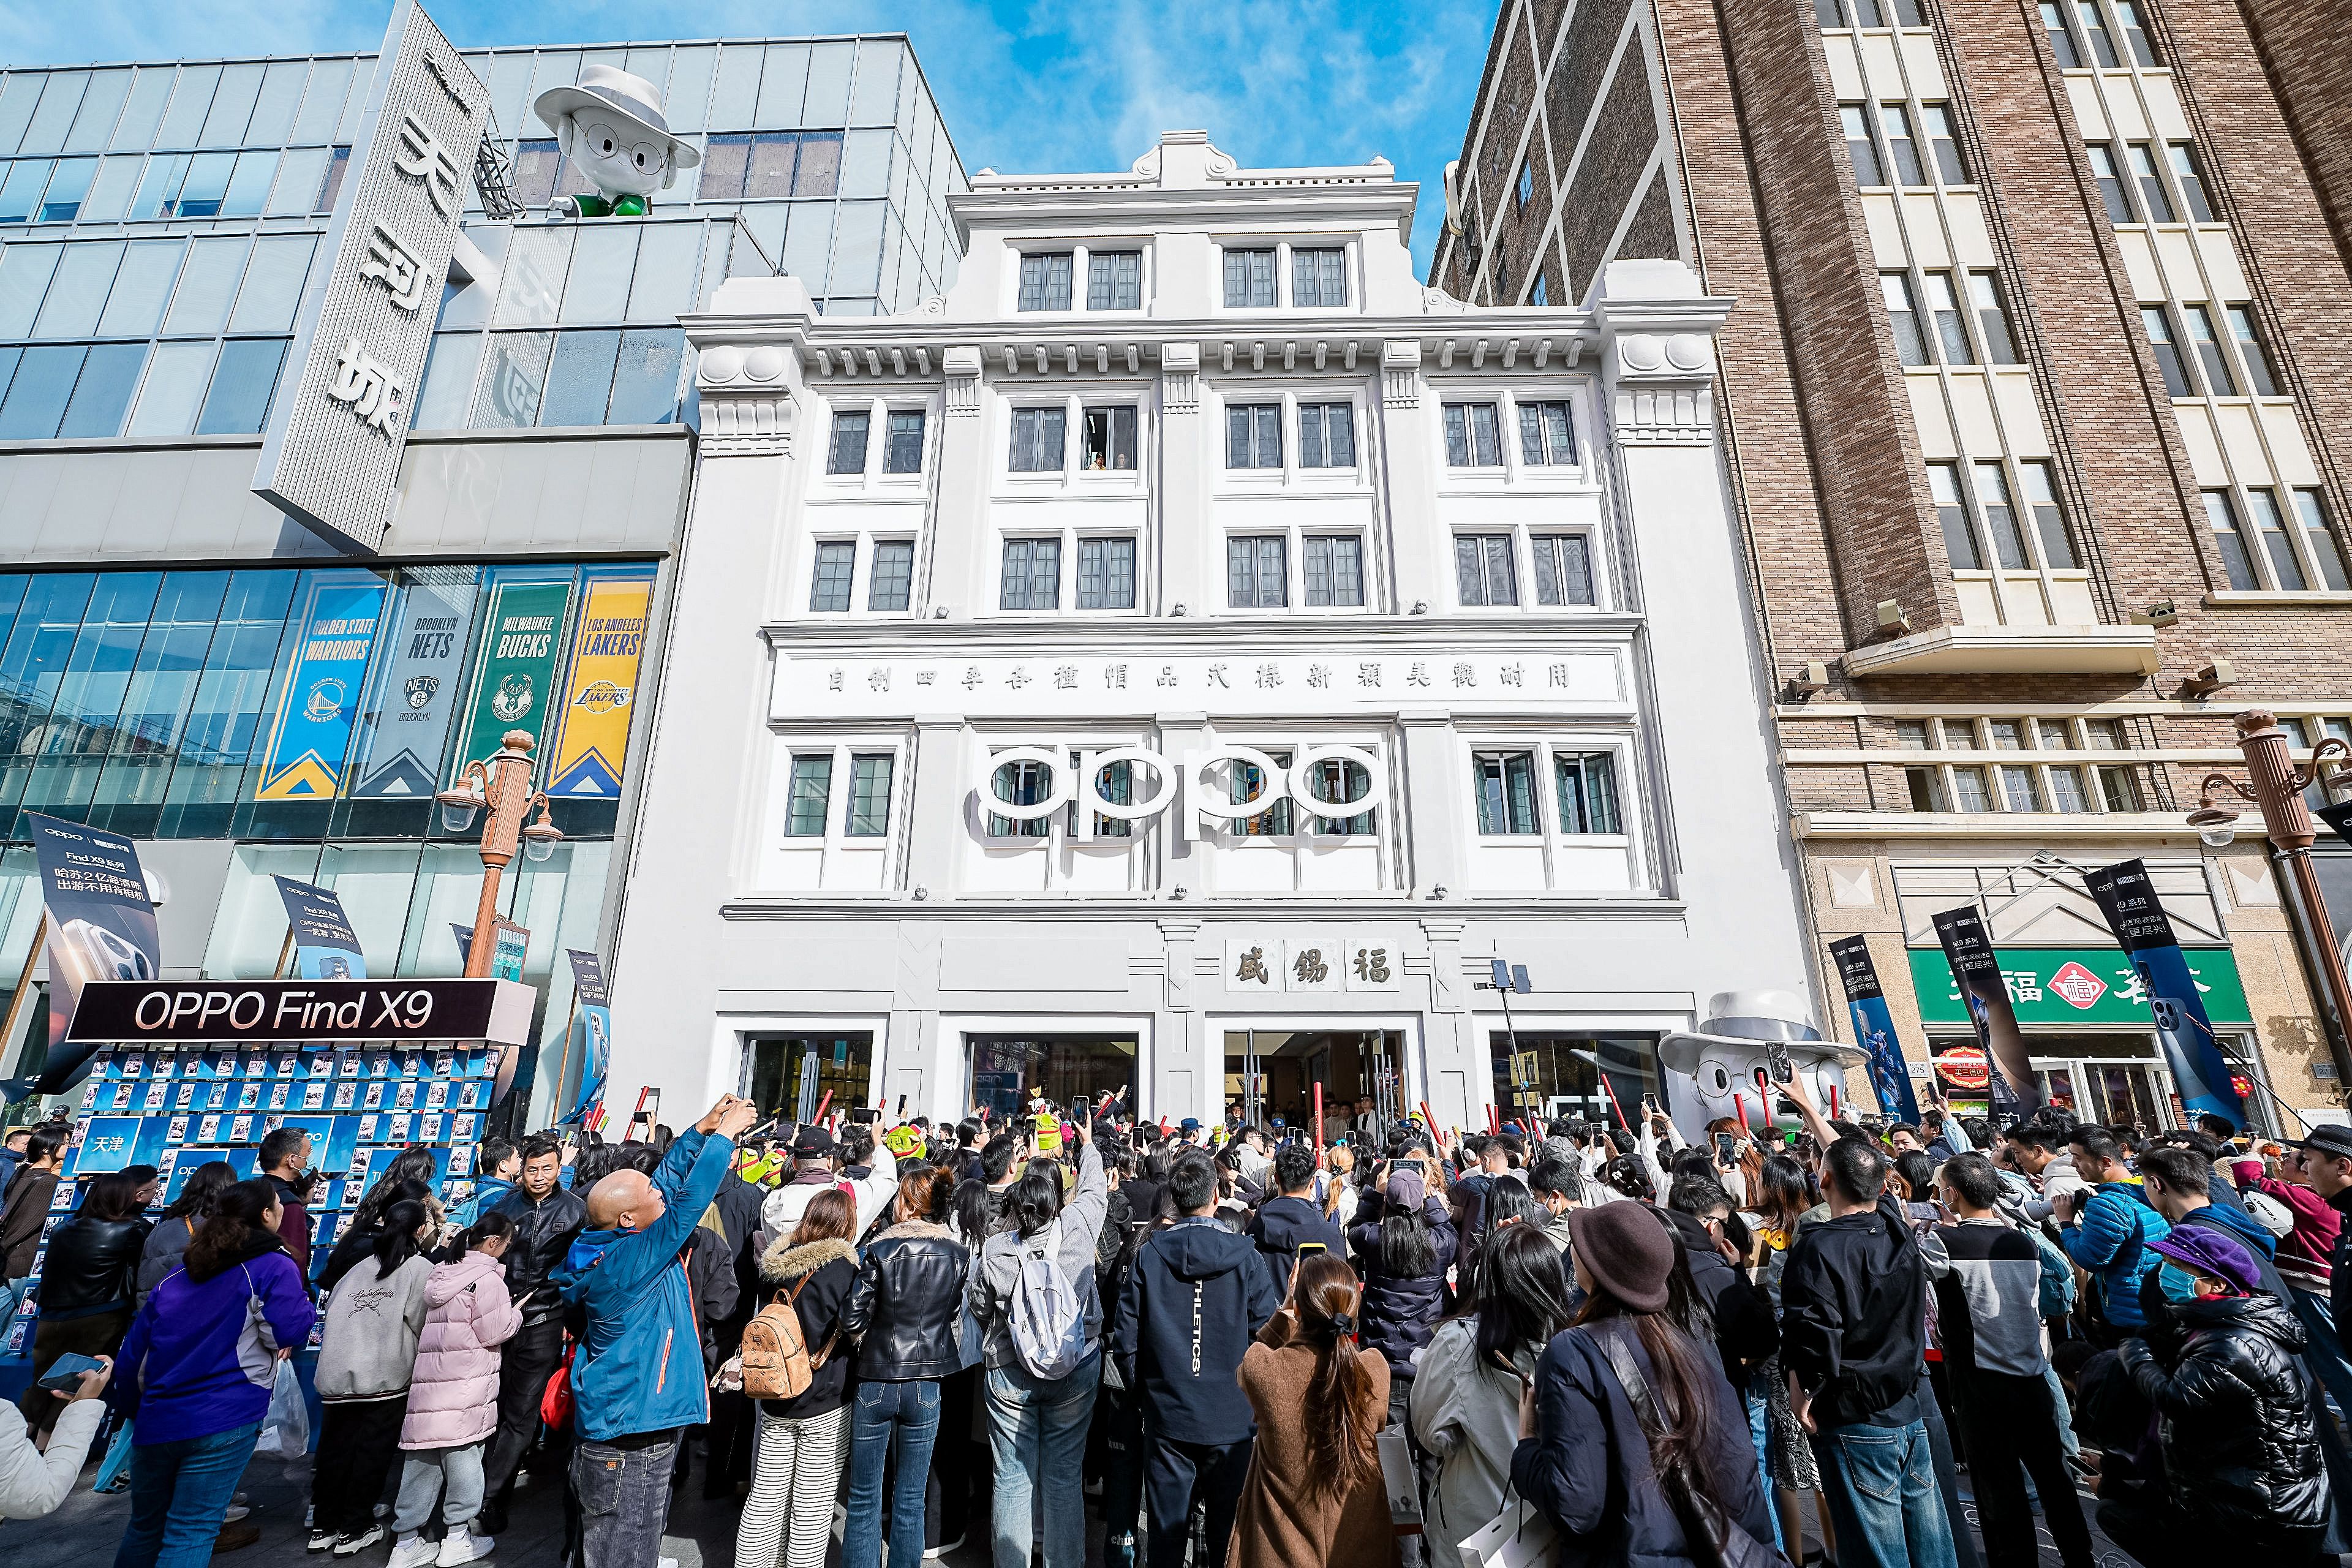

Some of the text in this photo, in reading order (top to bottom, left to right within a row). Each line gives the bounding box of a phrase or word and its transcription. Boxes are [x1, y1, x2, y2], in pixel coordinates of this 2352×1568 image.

[328, 109, 461, 440] 天河城
[313, 619, 375, 635] GOLDEN STATE
[414, 617, 458, 631] BROOKLYN
[502, 616, 554, 631] MILWAUKEE
[587, 618, 643, 631] LOS ANGELES
[305, 639, 369, 661] WARRIORS
[408, 633, 454, 659] NETS
[496, 634, 552, 658] BUCKS
[582, 633, 640, 656] LAKERS
[334, 678, 347, 689] STATE
[407, 679, 437, 692] NETS
[575, 688, 627, 706] LAKERS
[303, 709, 342, 723] WARRIORS
[398, 712, 431, 722] BROOKLYN
[977, 745, 1384, 843] oppo
[45, 828, 83, 840] oppo
[66, 851, 89, 862] Find
[91, 855, 105, 864] X9
[105, 859, 126, 870] 系列
[57, 879, 146, 902] 出游不用背相机
[286, 887, 310, 897] oppo
[2097, 880, 2114, 892] opp
[2128, 897, 2146, 907] 系列
[135, 990, 432, 1030] OPPO Find X9
[92, 1136, 125, 1153] 天津
